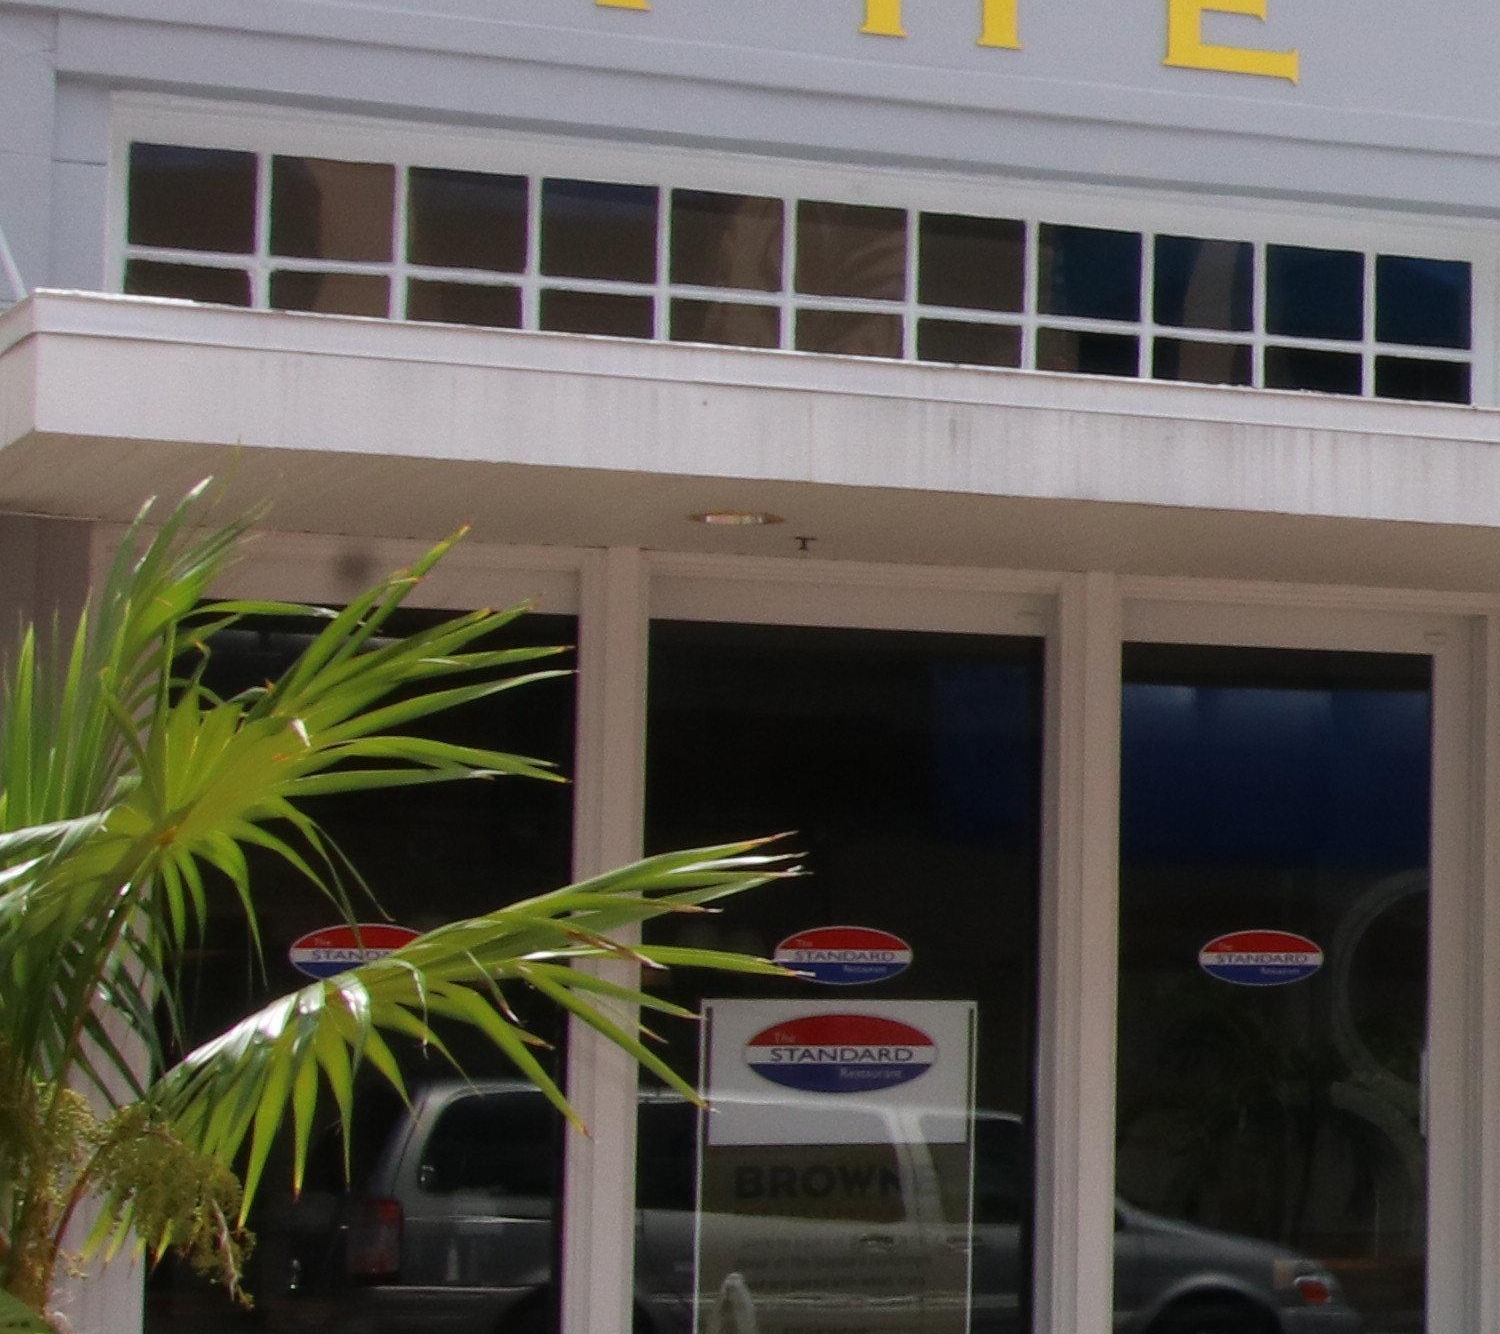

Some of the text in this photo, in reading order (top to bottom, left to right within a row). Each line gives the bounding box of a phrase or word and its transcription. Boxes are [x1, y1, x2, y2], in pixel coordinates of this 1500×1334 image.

[795, 951, 896, 963] STANDARD
[1216, 953, 1309, 965] STANDARD
[769, 1047, 914, 1063] STANDARD
